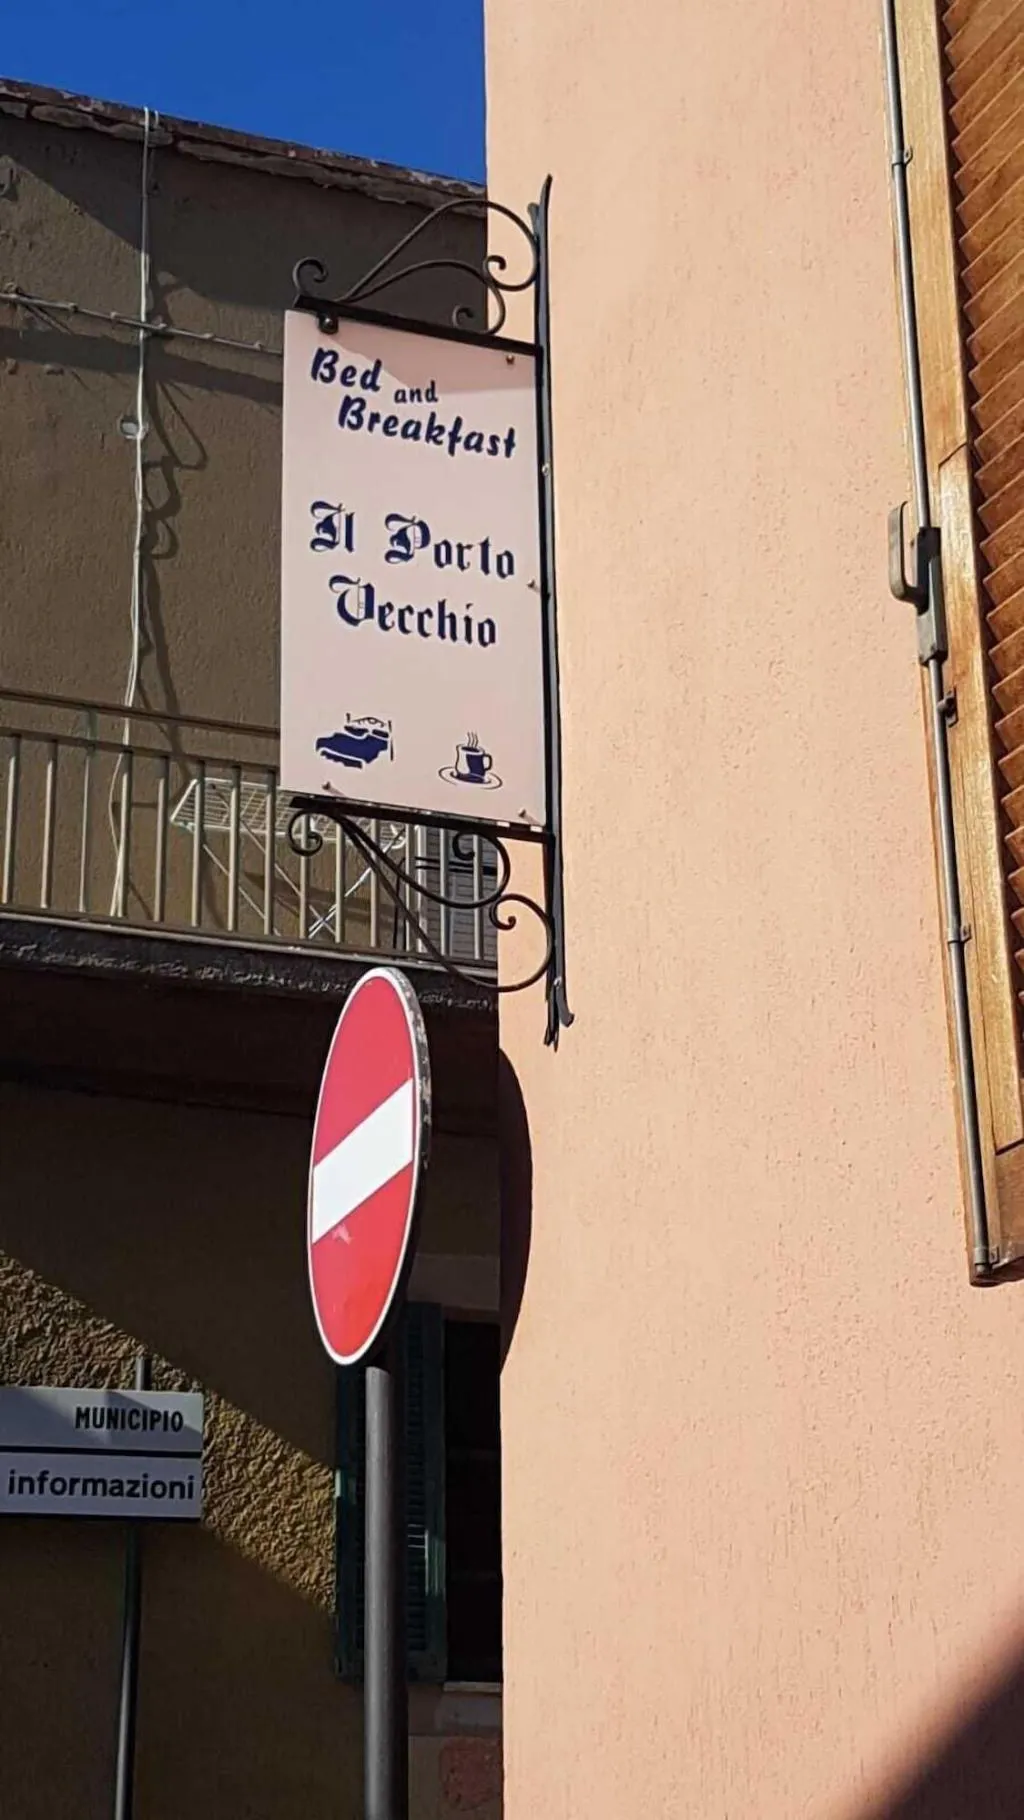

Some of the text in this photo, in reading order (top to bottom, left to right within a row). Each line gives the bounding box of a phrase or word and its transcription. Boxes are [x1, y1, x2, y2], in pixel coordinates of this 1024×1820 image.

[310, 347, 438, 404] Bed and
[337, 395, 516, 459] Breakfast
[309, 500, 515, 580] Il Porto
[328, 575, 497, 648] Vecchio
[75, 1406, 184, 1432] MUNICIPIO
[8, 1468, 195, 1499] informazioni
